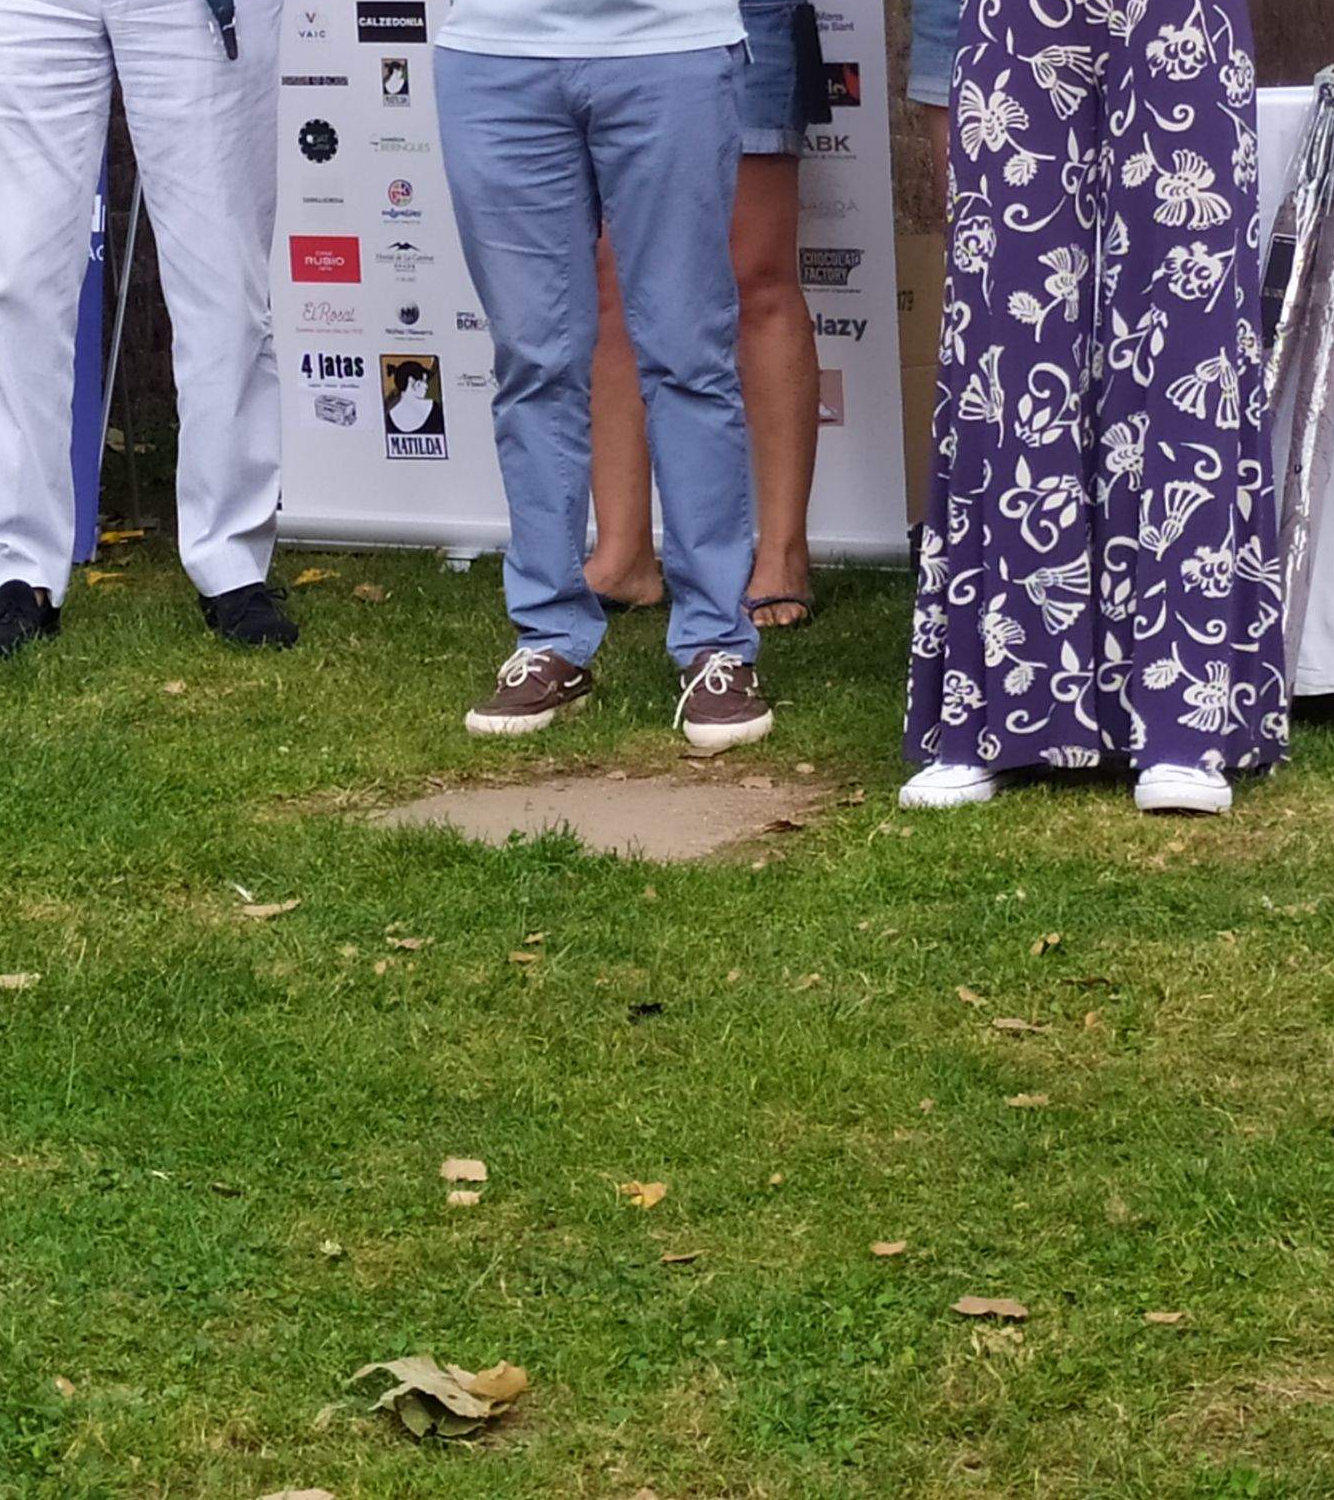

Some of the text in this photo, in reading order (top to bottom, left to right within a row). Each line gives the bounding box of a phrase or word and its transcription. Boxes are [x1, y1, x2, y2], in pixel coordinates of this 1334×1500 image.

[358, 16, 424, 28] CALZEDONIA
[815, 312, 868, 342] lazy
[300, 352, 365, 380] 4 latas
[391, 436, 444, 456] MATILDA
